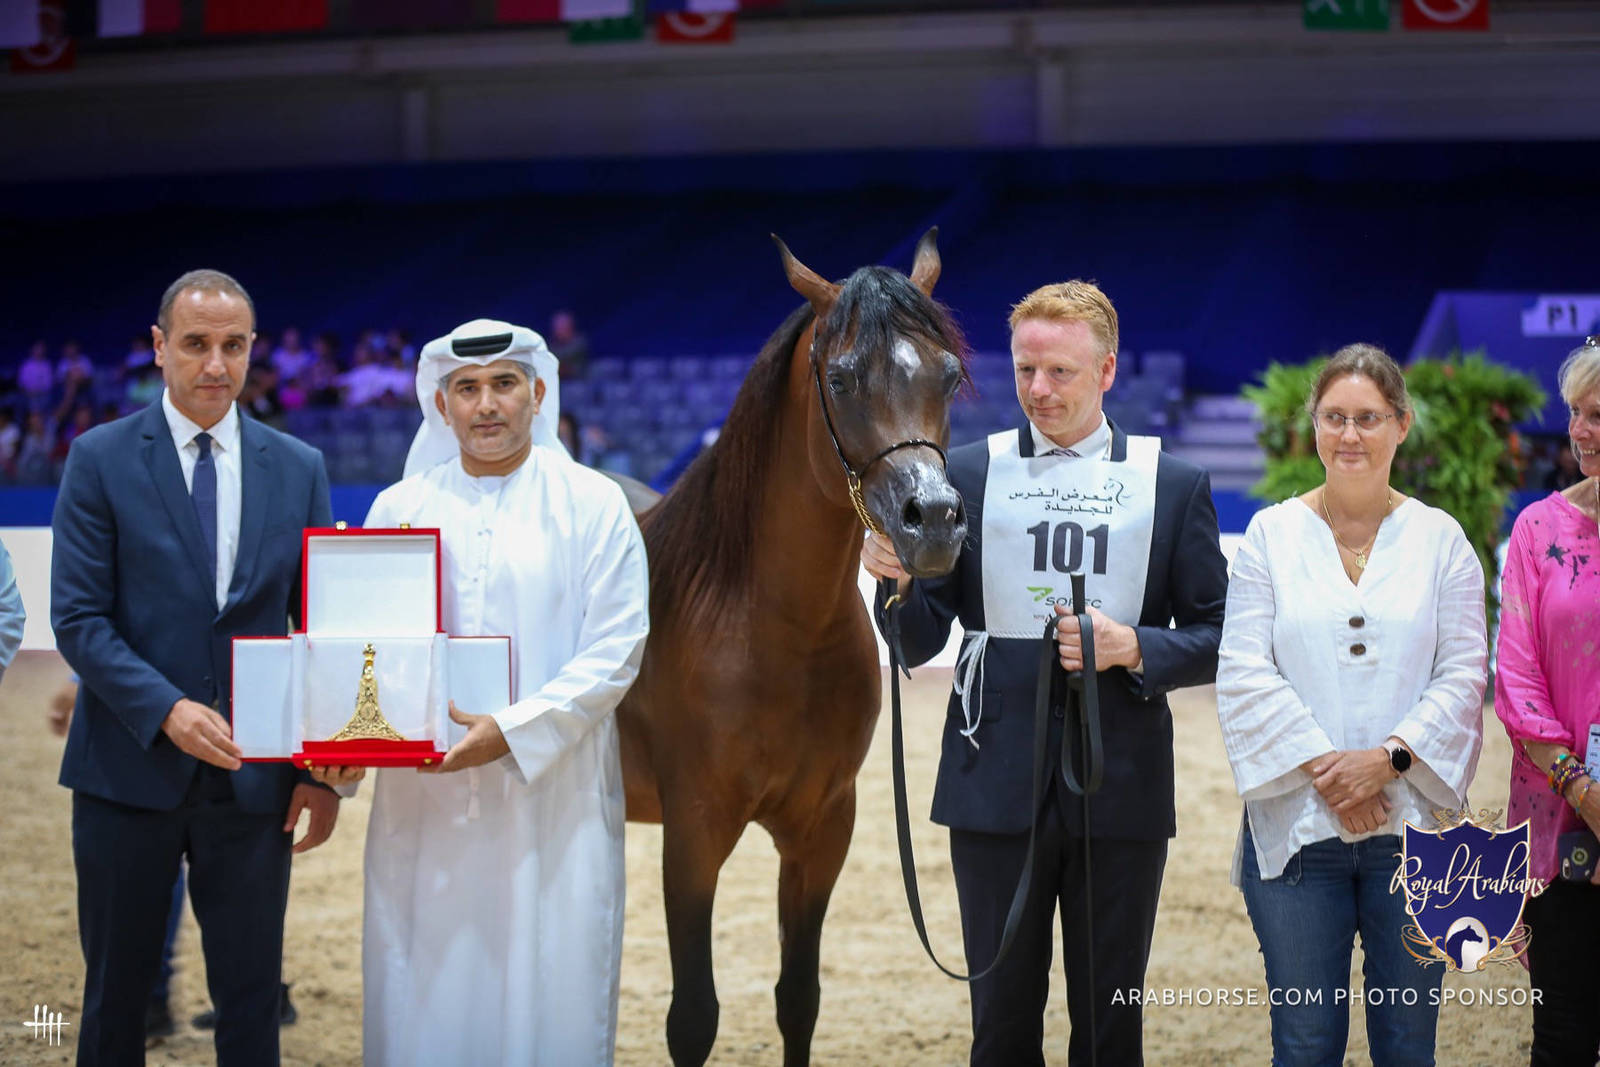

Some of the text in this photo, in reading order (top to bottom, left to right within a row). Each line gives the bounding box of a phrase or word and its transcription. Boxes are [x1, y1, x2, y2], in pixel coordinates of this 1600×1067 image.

[1009, 488, 1113, 502] معرض الفرس
[1044, 501, 1113, 516] للجديدة
[1027, 520, 1110, 575] 101
